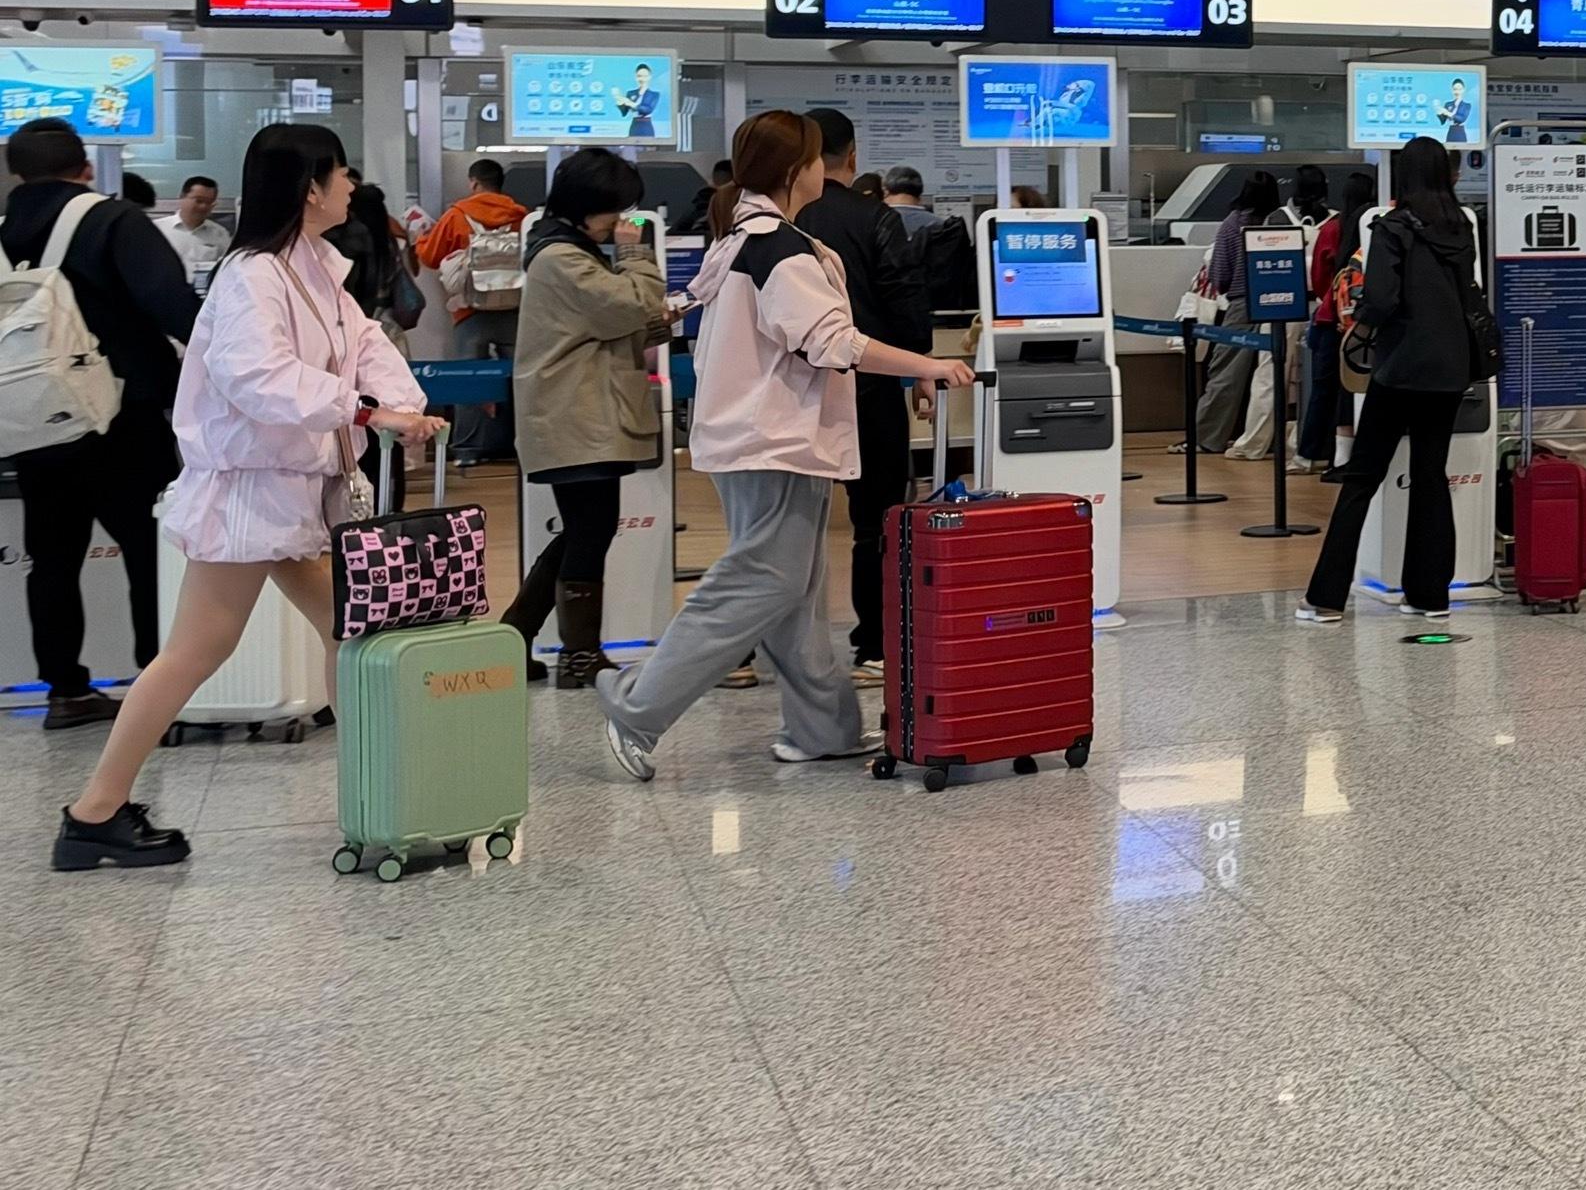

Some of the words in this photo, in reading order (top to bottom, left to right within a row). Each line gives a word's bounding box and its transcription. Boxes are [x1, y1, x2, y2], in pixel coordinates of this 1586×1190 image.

[1499, 8, 1535, 34] 04
[835, 74, 952, 86] 行李运输安全规定
[1005, 234, 1078, 250] 暂停服务
